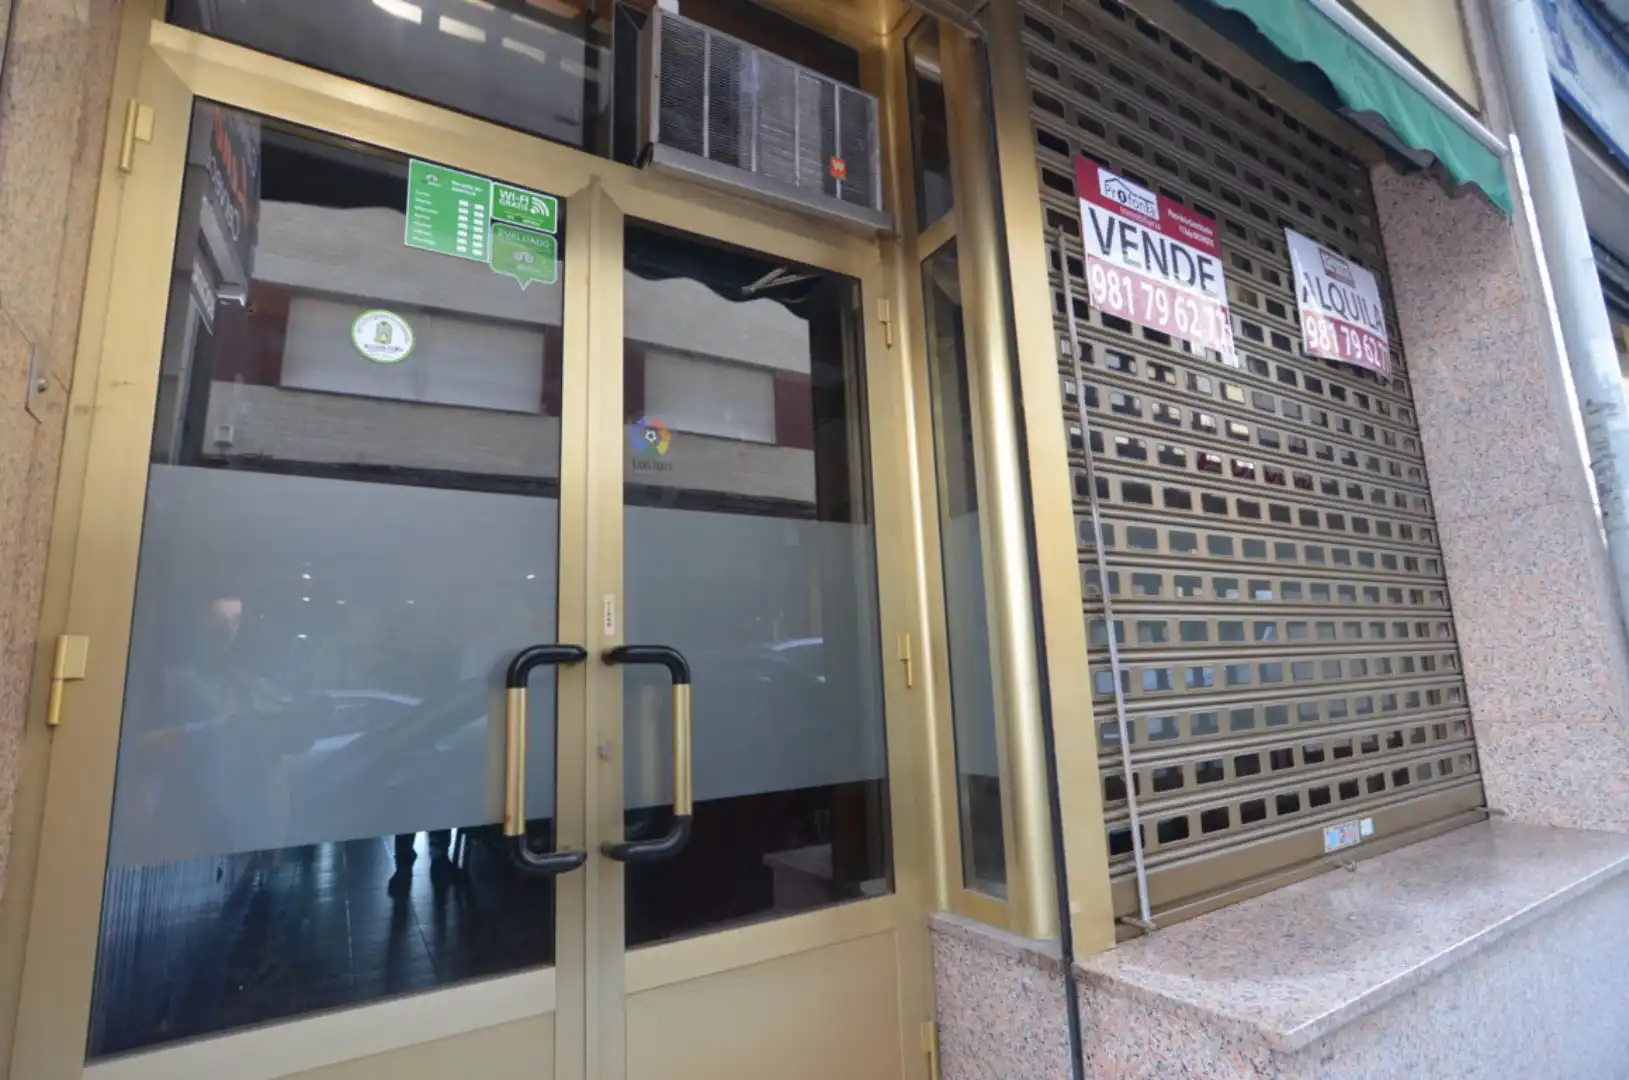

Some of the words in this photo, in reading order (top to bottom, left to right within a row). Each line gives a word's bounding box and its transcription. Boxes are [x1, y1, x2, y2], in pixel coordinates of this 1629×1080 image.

[1088, 206, 1218, 298] VENDE
[1091, 263, 1135, 316] 981
[1140, 281, 1170, 316] 79
[1174, 295, 1202, 337] 62
[1303, 272, 1384, 335] ALQUILA
